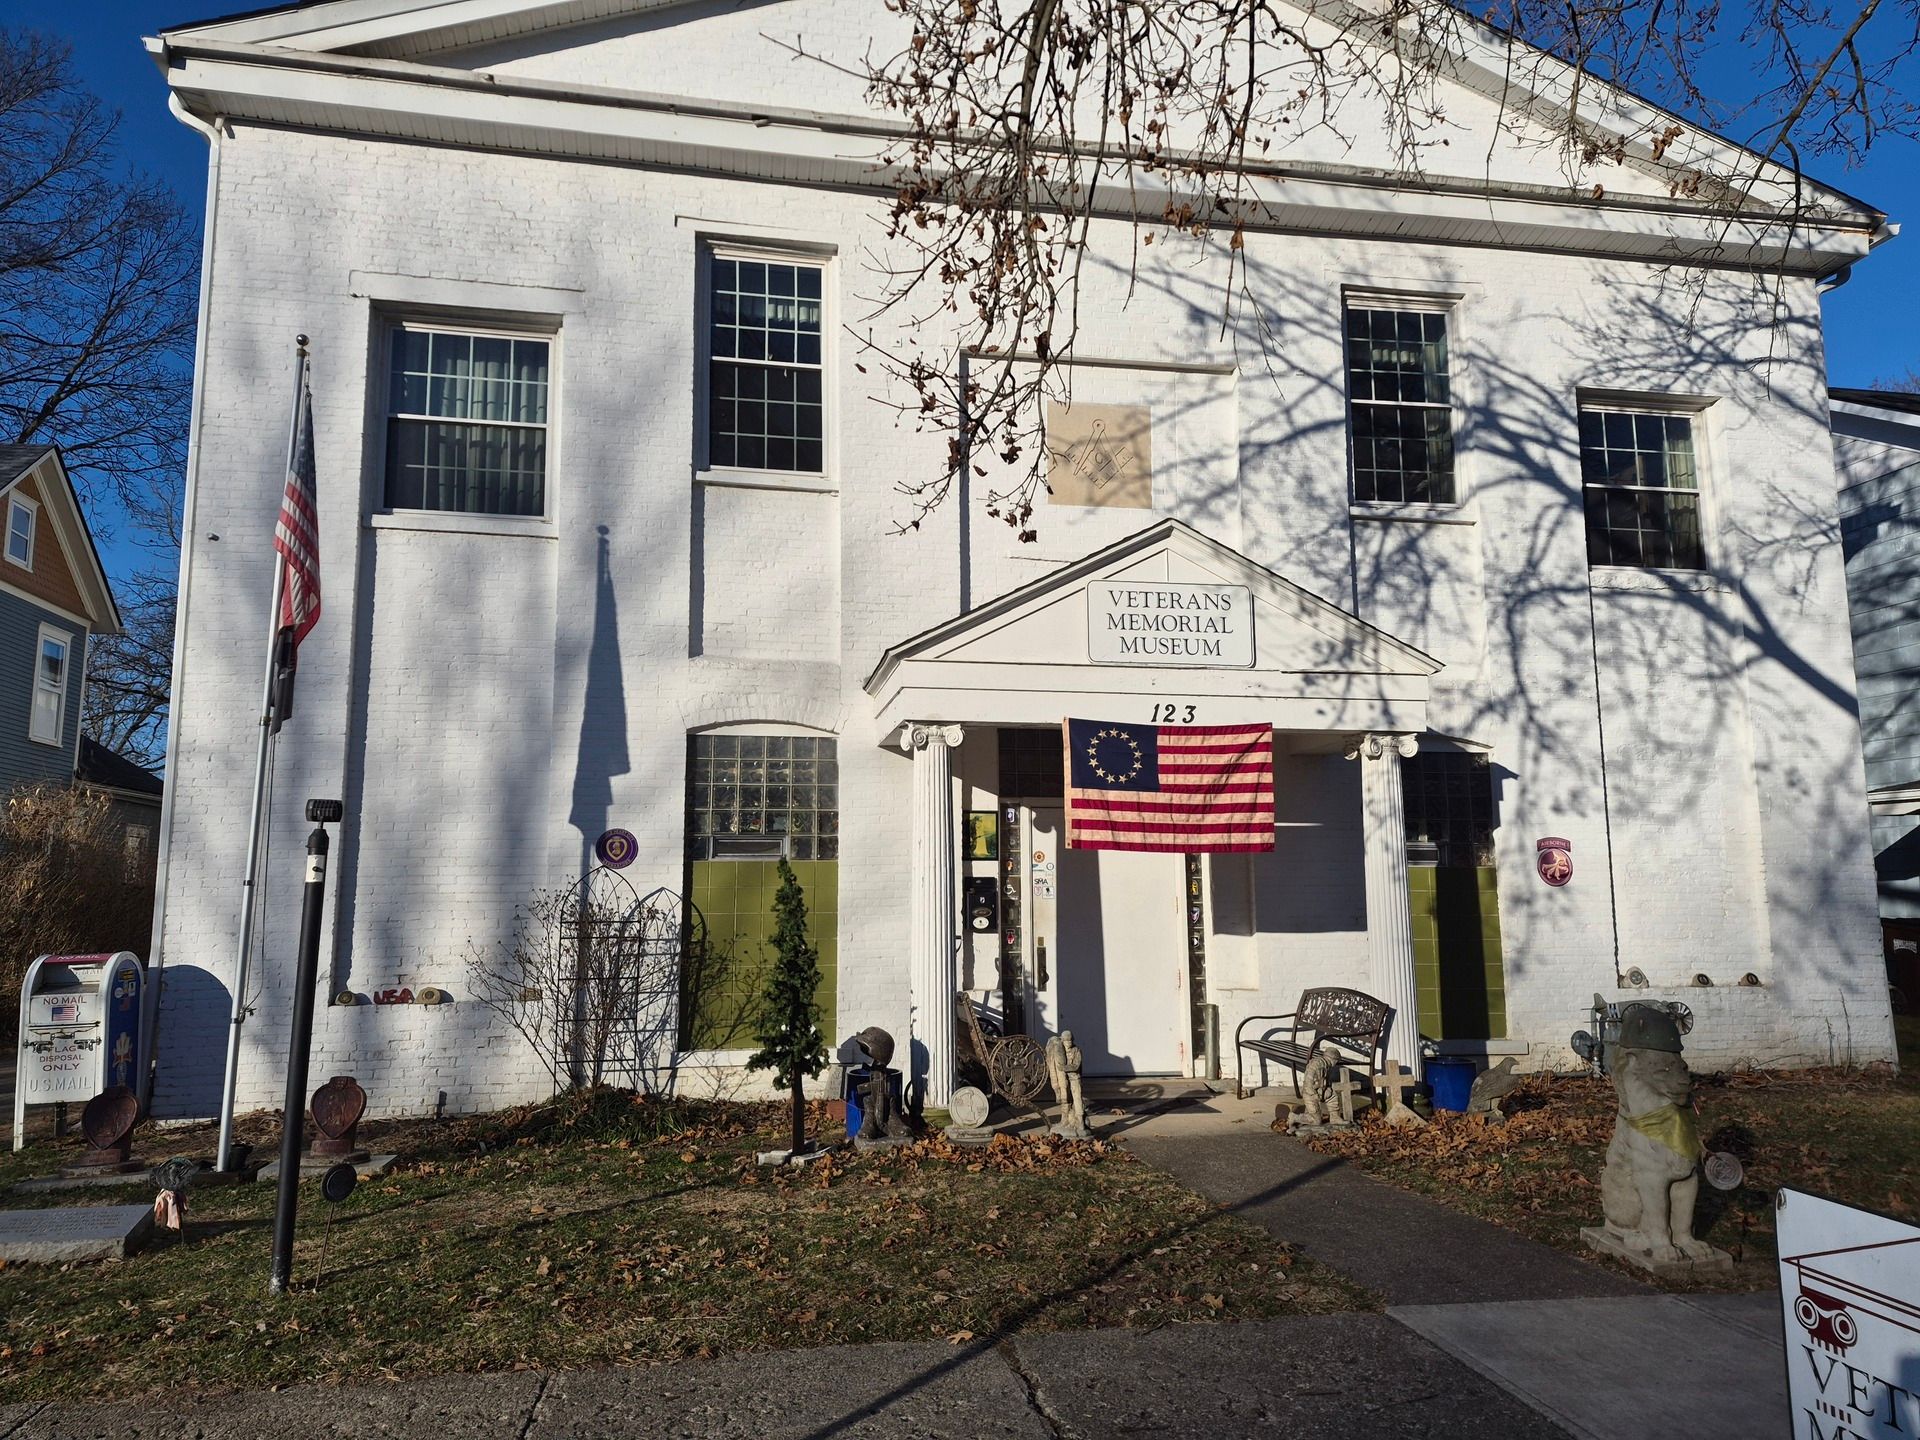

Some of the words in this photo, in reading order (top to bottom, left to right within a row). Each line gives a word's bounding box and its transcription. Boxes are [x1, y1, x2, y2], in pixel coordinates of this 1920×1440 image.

[1108, 590, 1232, 611] VETERANS
[1106, 613, 1234, 634] MEMORIAL
[1119, 636, 1222, 657] MUSEUM
[1151, 703, 1197, 724] 123
[43, 997, 59, 1005] NO
[61, 995, 87, 1004] MAIL
[39, 1054, 84, 1062] DISPOSAL
[42, 1063, 80, 1072] ONLY
[1801, 1343, 1920, 1432] VET
